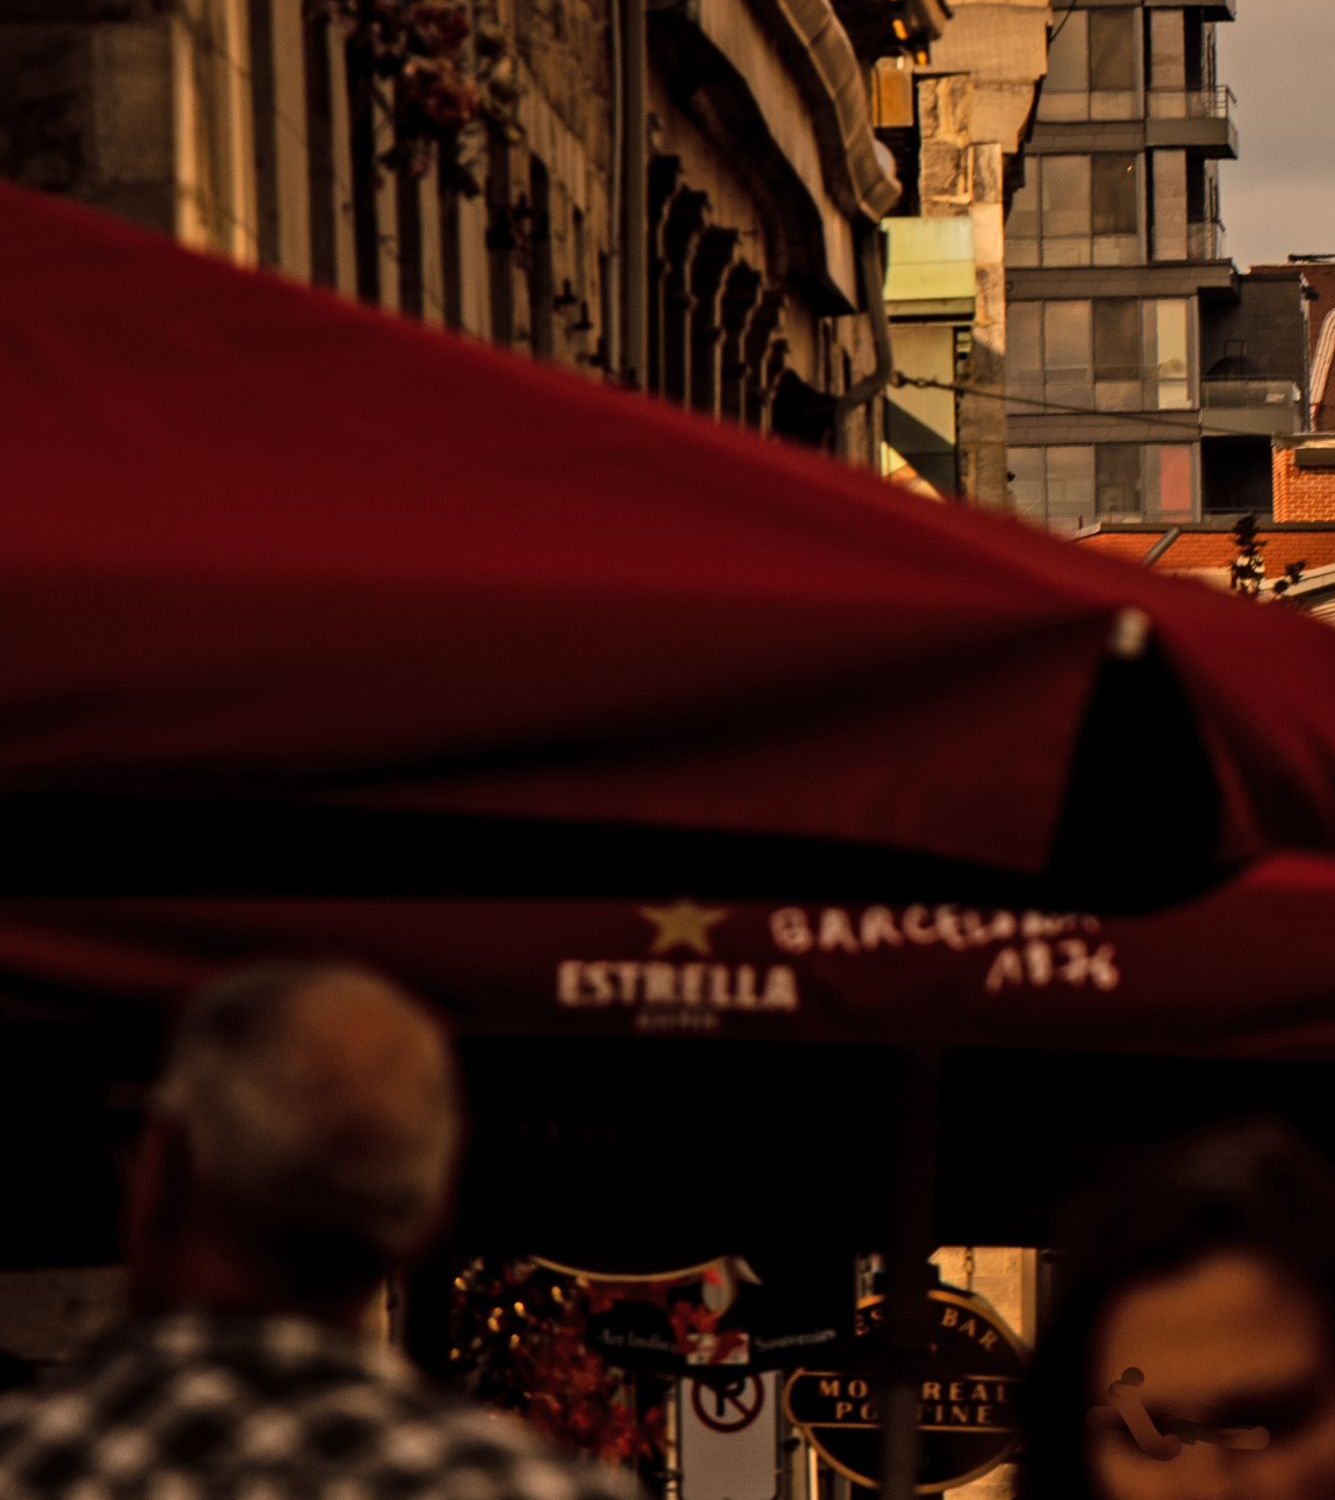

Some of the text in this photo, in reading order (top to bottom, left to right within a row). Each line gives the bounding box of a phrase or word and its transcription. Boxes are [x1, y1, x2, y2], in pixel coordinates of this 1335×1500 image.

[557, 960, 798, 1012] ESTRELLA
[940, 1305, 999, 1351] BAR
[818, 1378, 1009, 1403] MOREAL
[835, 1402, 994, 1424] POTINE
